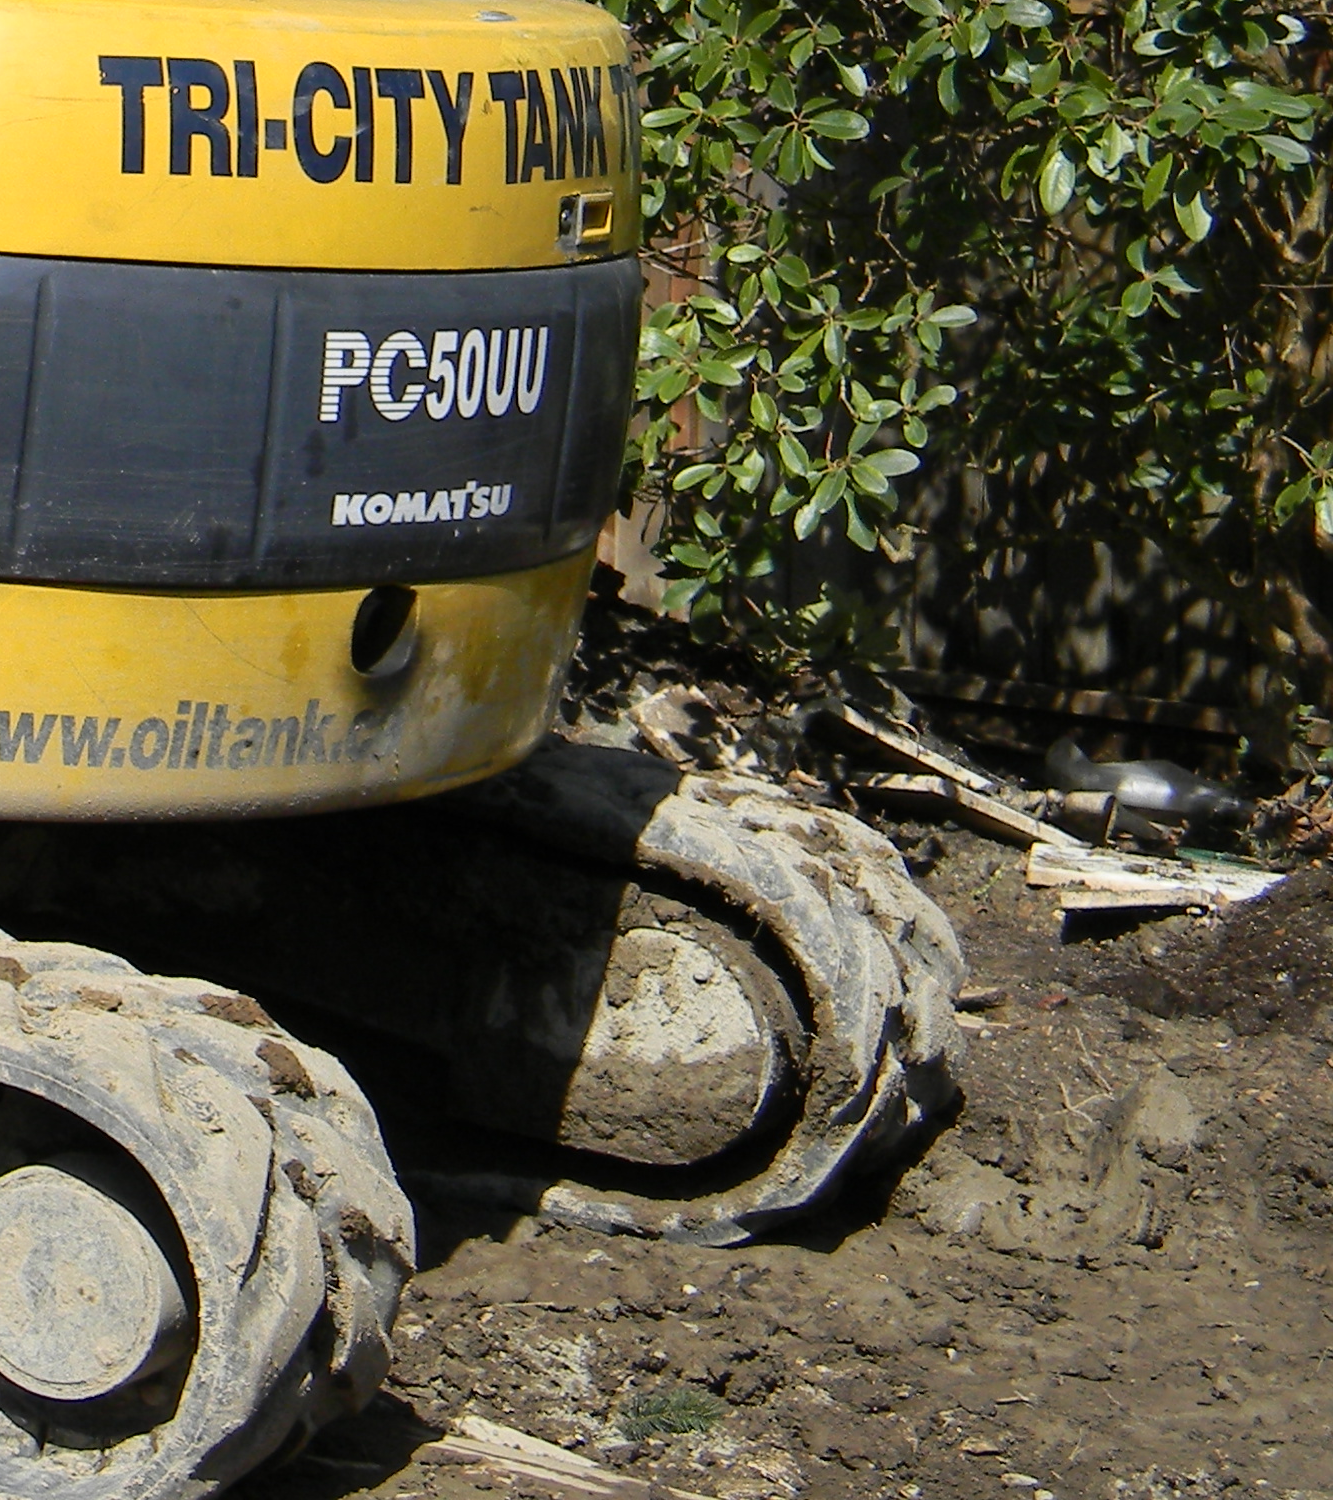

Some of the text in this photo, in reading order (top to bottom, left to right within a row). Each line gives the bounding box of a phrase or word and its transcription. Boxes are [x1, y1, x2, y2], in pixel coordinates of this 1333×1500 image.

[98, 55, 474, 185] TRI-CITY
[488, 66, 608, 185] TANK
[319, 325, 548, 422] PC50UU
[332, 480, 512, 527] KOMATSU
